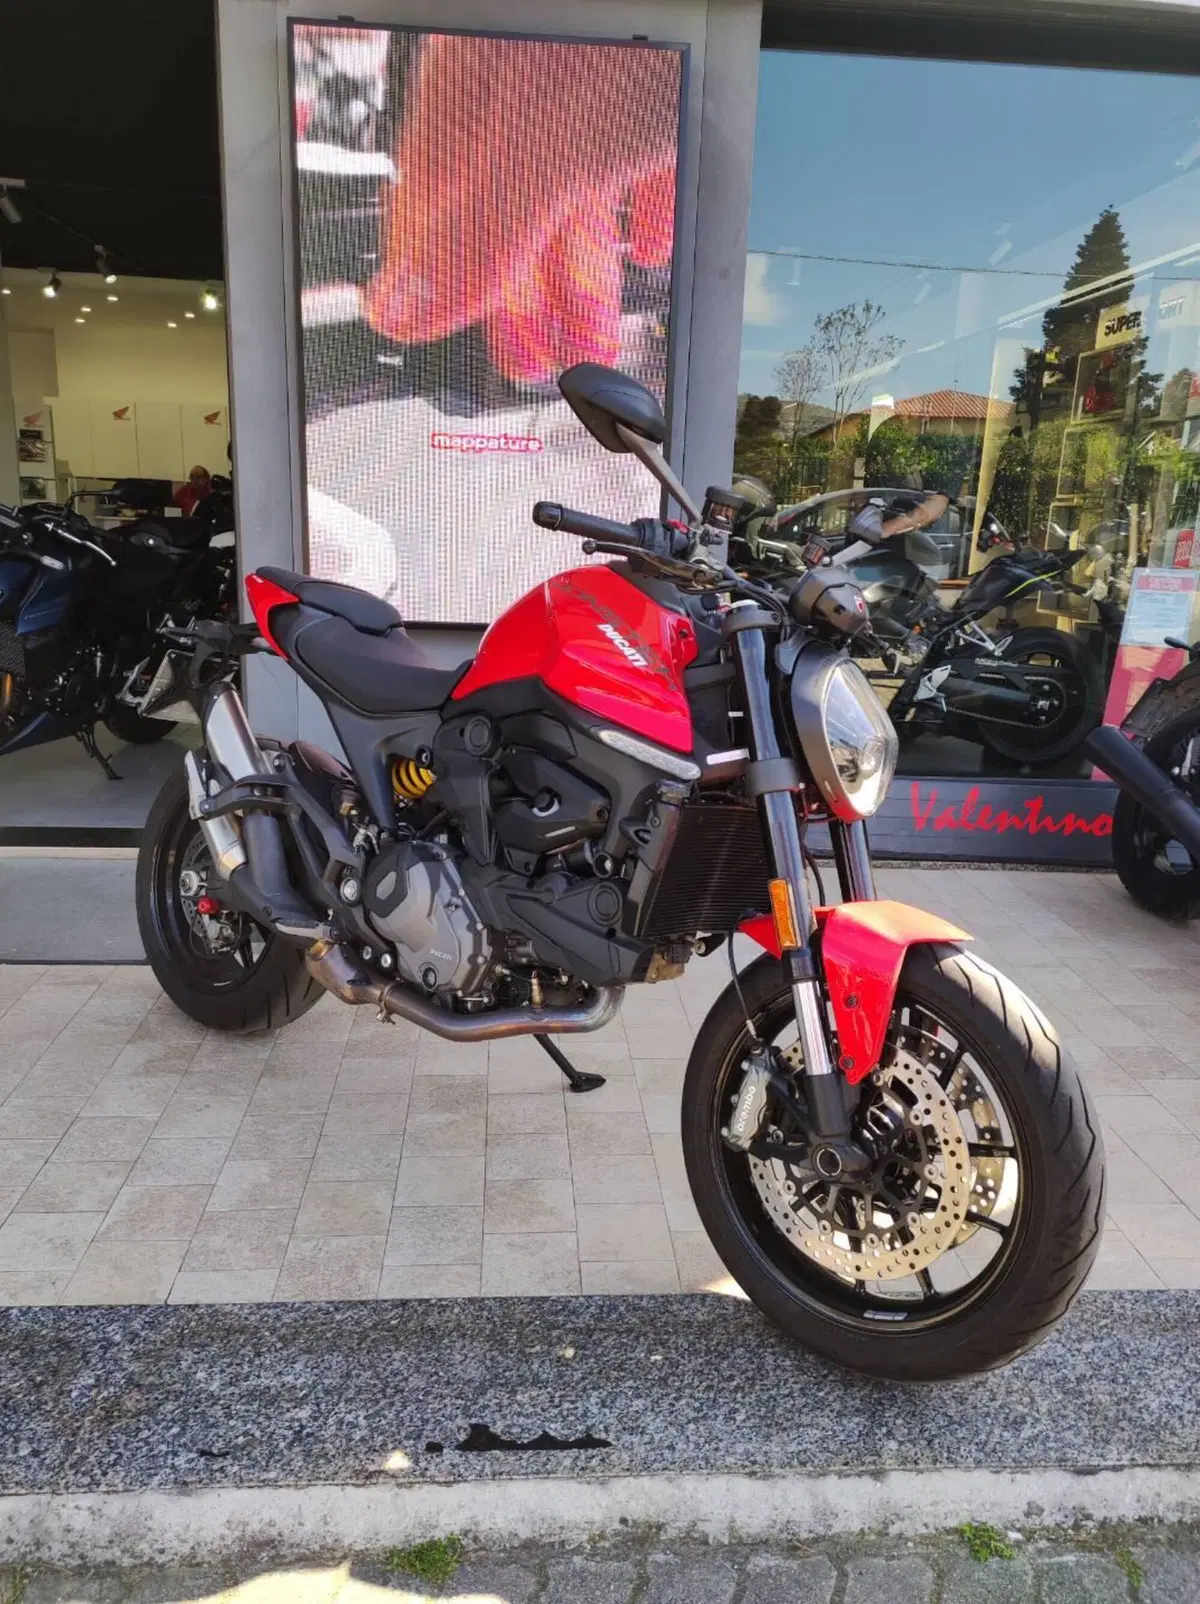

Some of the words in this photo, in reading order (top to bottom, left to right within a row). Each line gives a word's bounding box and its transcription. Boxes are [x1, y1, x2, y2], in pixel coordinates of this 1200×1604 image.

[431, 433, 543, 453] mappature
[596, 623, 648, 667] DUCATI
[910, 780, 1113, 836] Valentino
[736, 1085, 757, 1132] brembo
